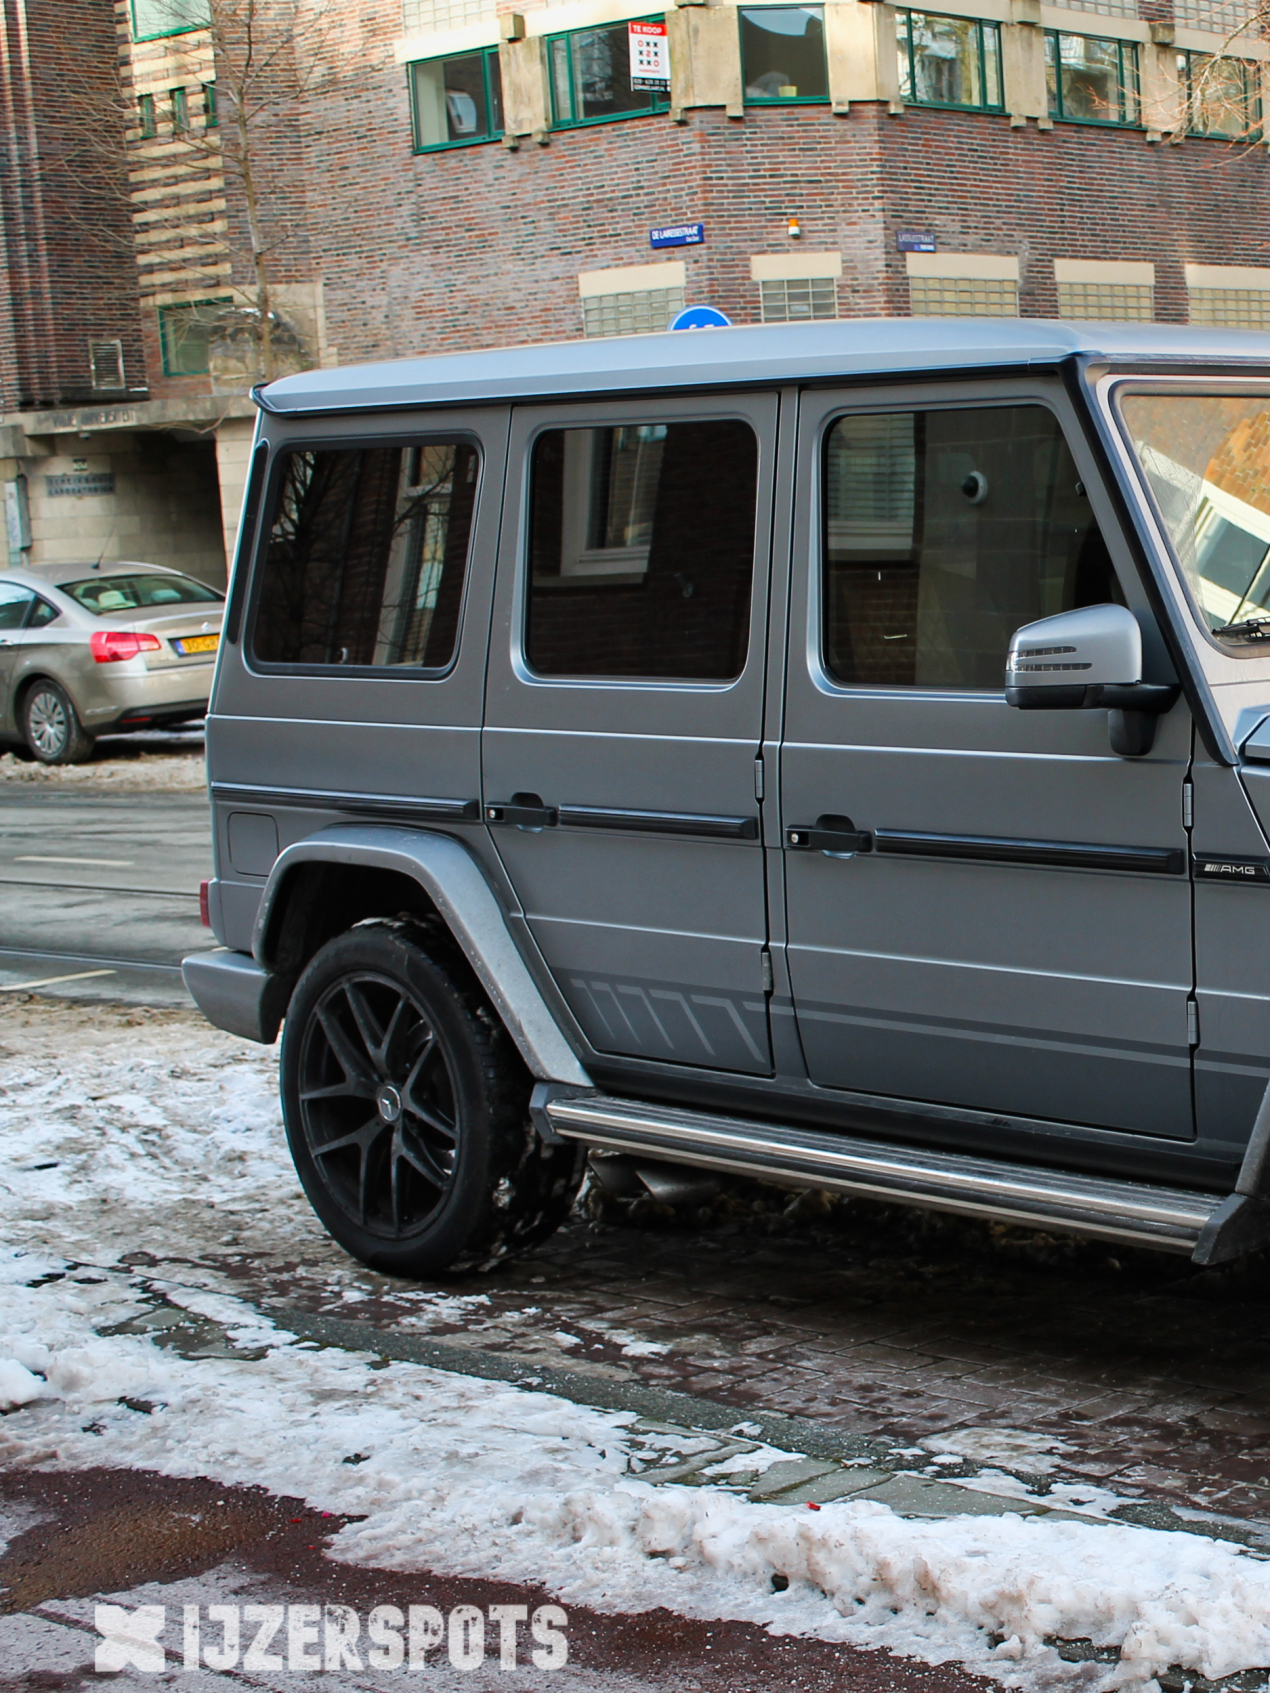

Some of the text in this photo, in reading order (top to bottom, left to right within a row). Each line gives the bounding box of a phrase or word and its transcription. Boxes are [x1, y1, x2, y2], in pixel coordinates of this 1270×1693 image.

[633, 25, 663, 34] TE KOOP
[651, 230, 660, 240] DE
[1220, 864, 1256, 875] AMG
